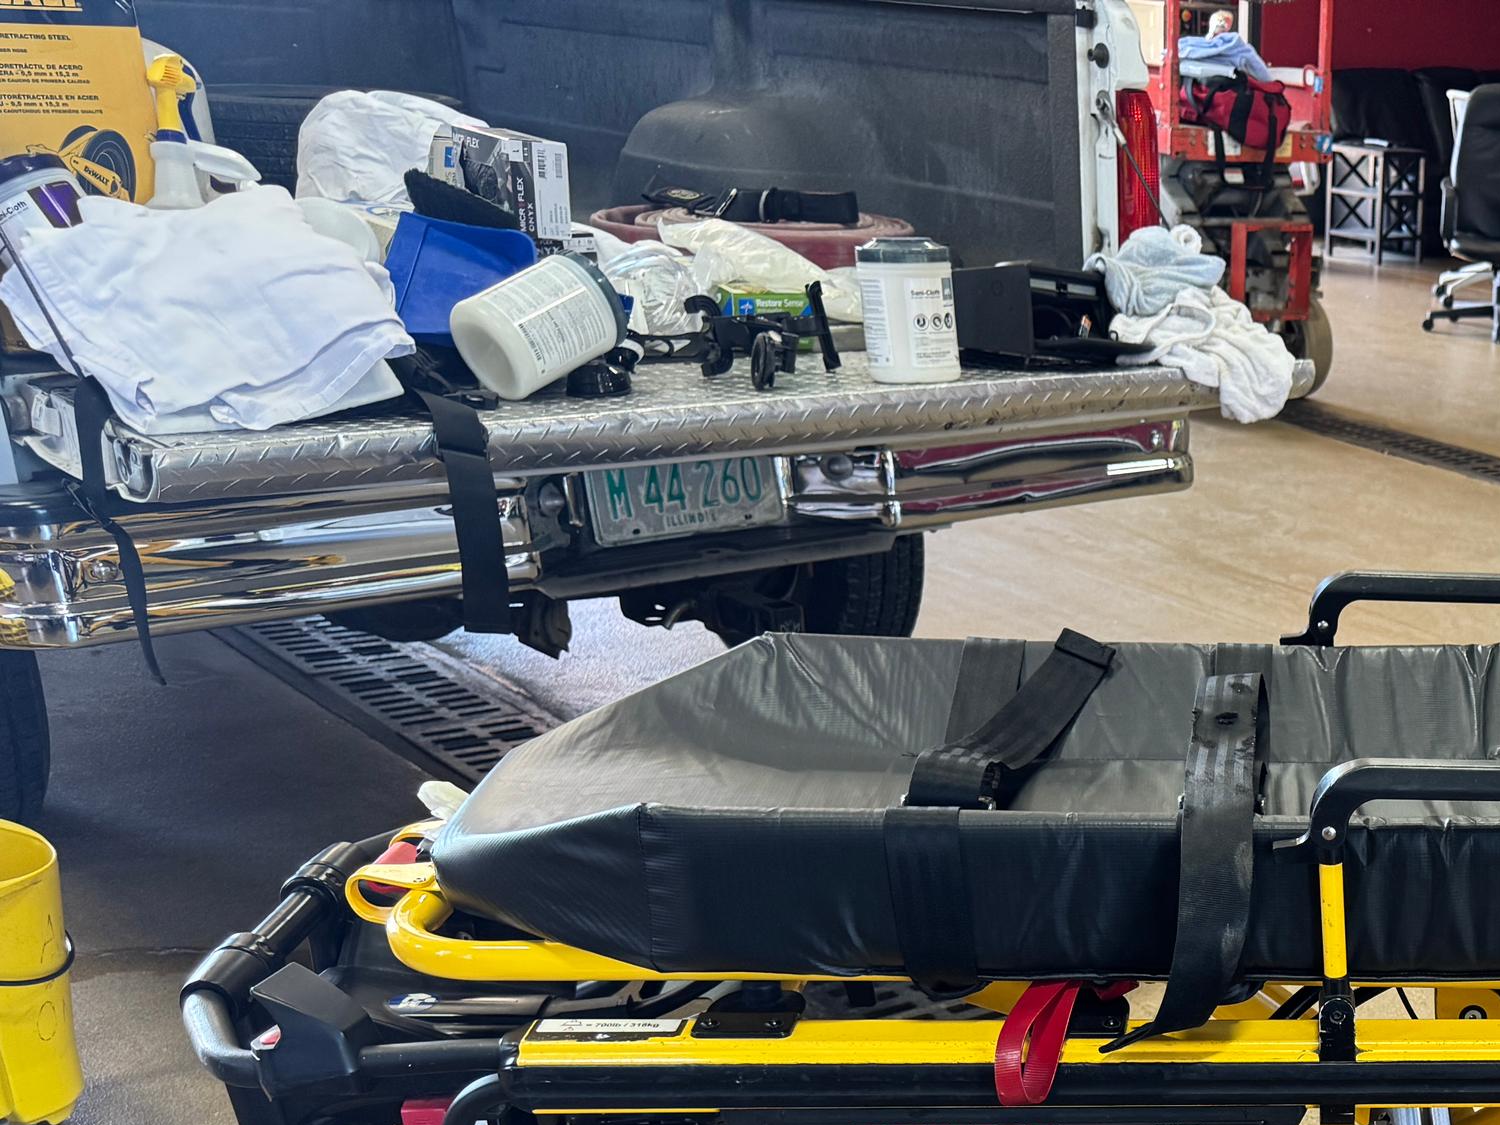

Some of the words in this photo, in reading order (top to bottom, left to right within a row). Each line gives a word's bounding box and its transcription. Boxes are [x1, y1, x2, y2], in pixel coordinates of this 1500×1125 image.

[527, 202, 535, 232] ONYX
[756, 299, 782, 309] Restore
[784, 299, 804, 309] Sense
[605, 469, 634, 520] M
[643, 464, 687, 514] 44
[694, 456, 763, 508] 260
